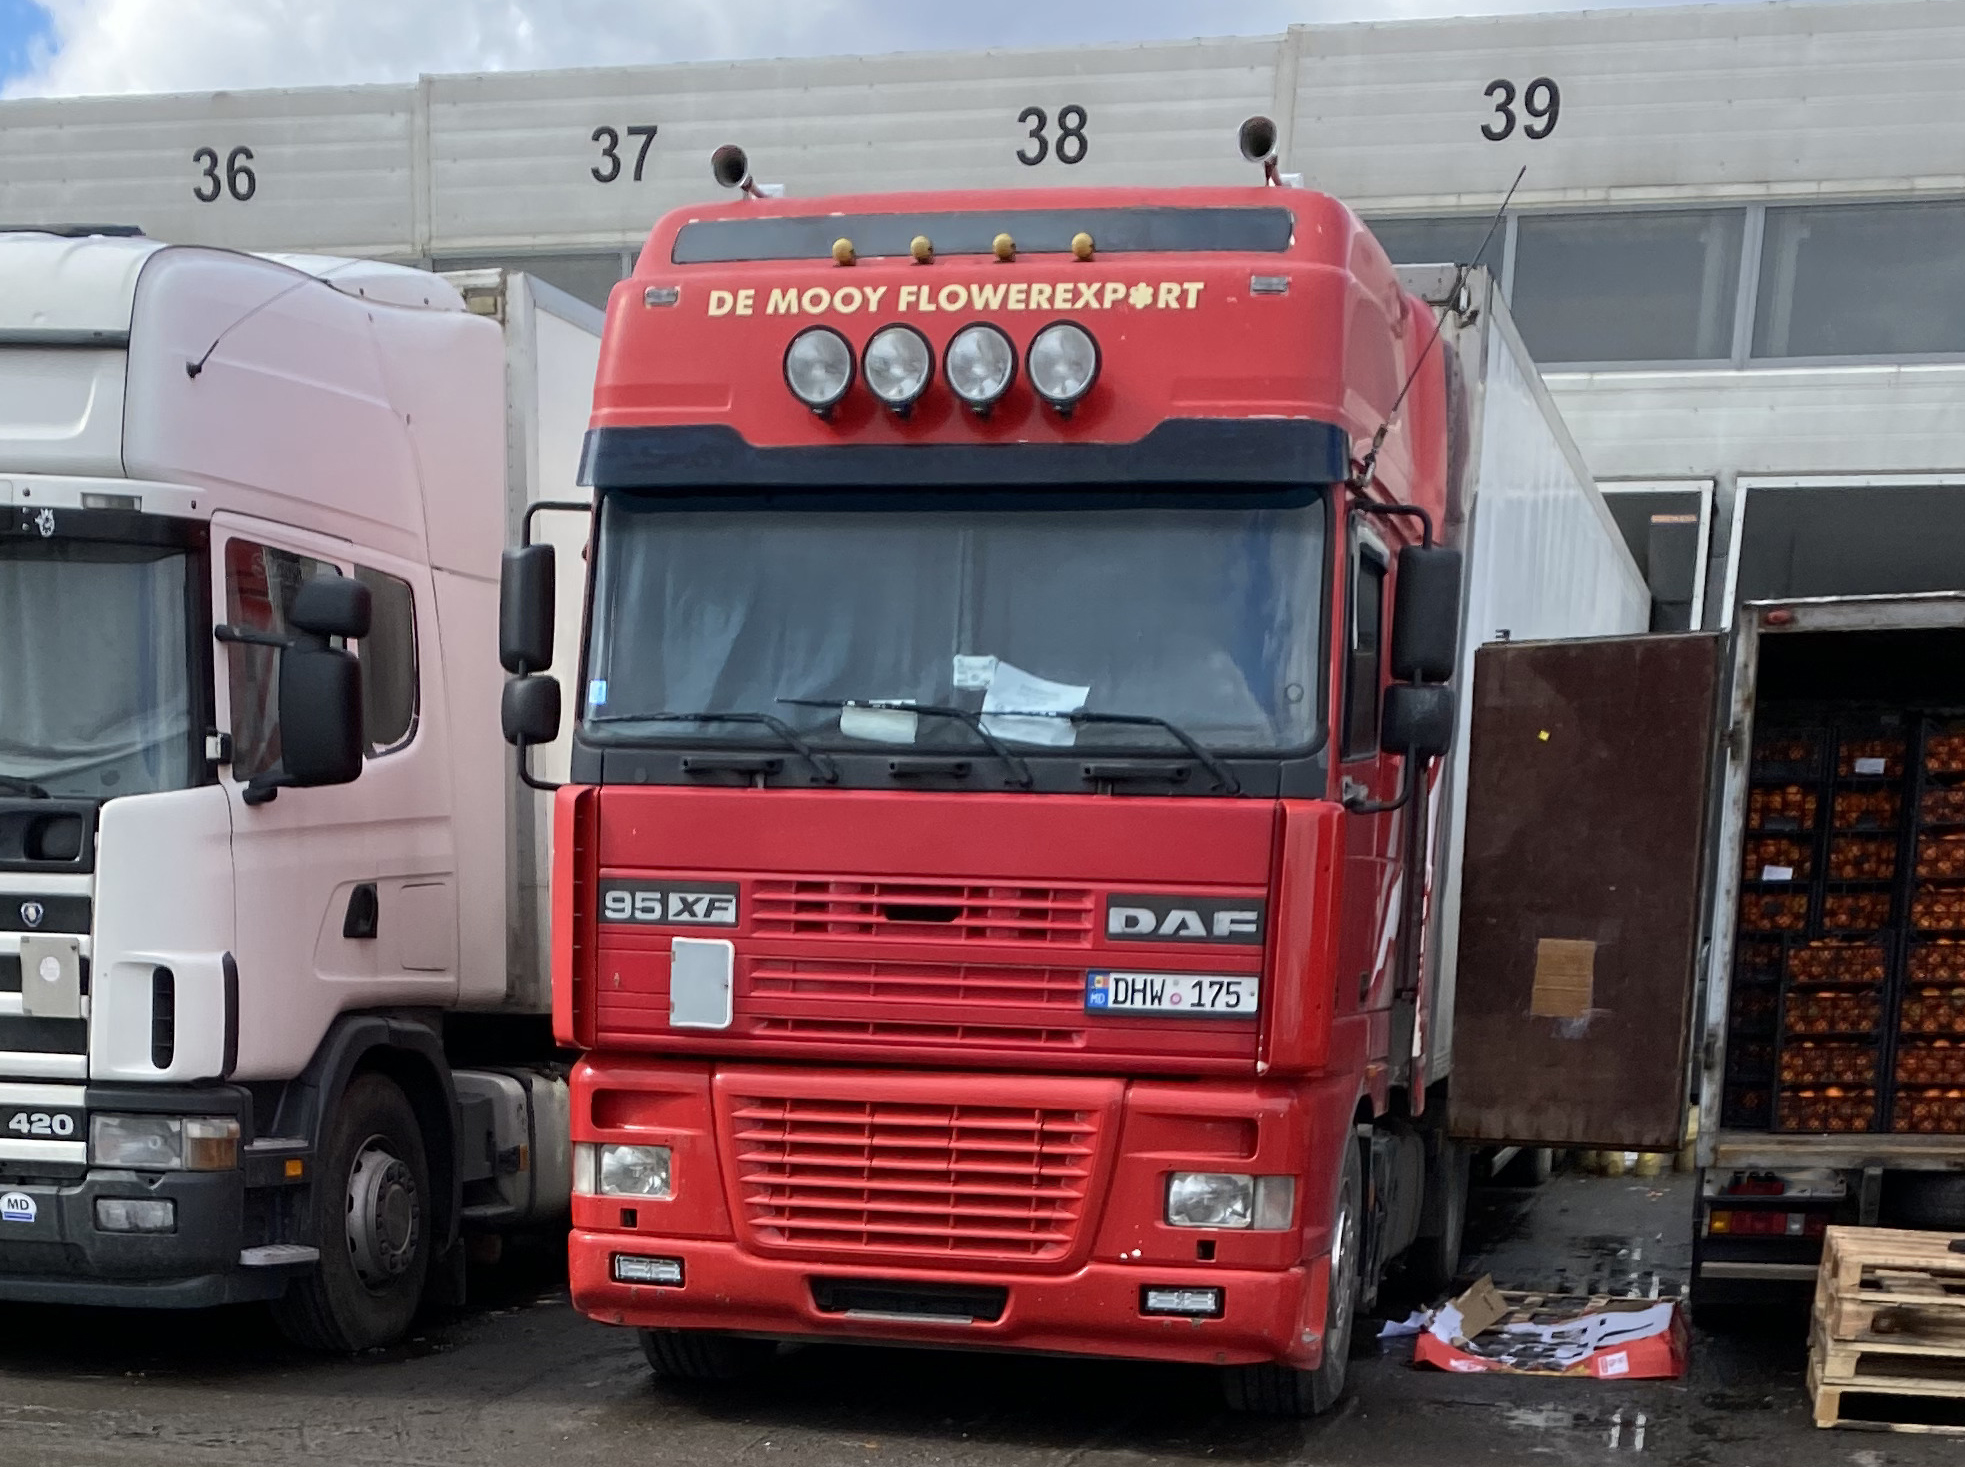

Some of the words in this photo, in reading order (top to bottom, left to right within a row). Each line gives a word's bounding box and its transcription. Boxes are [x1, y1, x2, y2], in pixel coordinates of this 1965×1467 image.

[1481, 77, 1560, 141] 39
[1016, 105, 1088, 166] 38
[591, 125, 658, 183] 37
[193, 146, 256, 202] 36
[708, 289, 755, 316] DE
[766, 286, 887, 314] MOOY
[605, 890, 662, 920] 95
[673, 895, 734, 918] XF
[1108, 907, 1258, 937] DAF
[1090, 993, 1106, 1004] MD
[1112, 977, 1166, 1006] DHW
[1190, 980, 1242, 1008] 175
[8, 1112, 74, 1135] 420
[7, 1198, 29, 1210] MD
